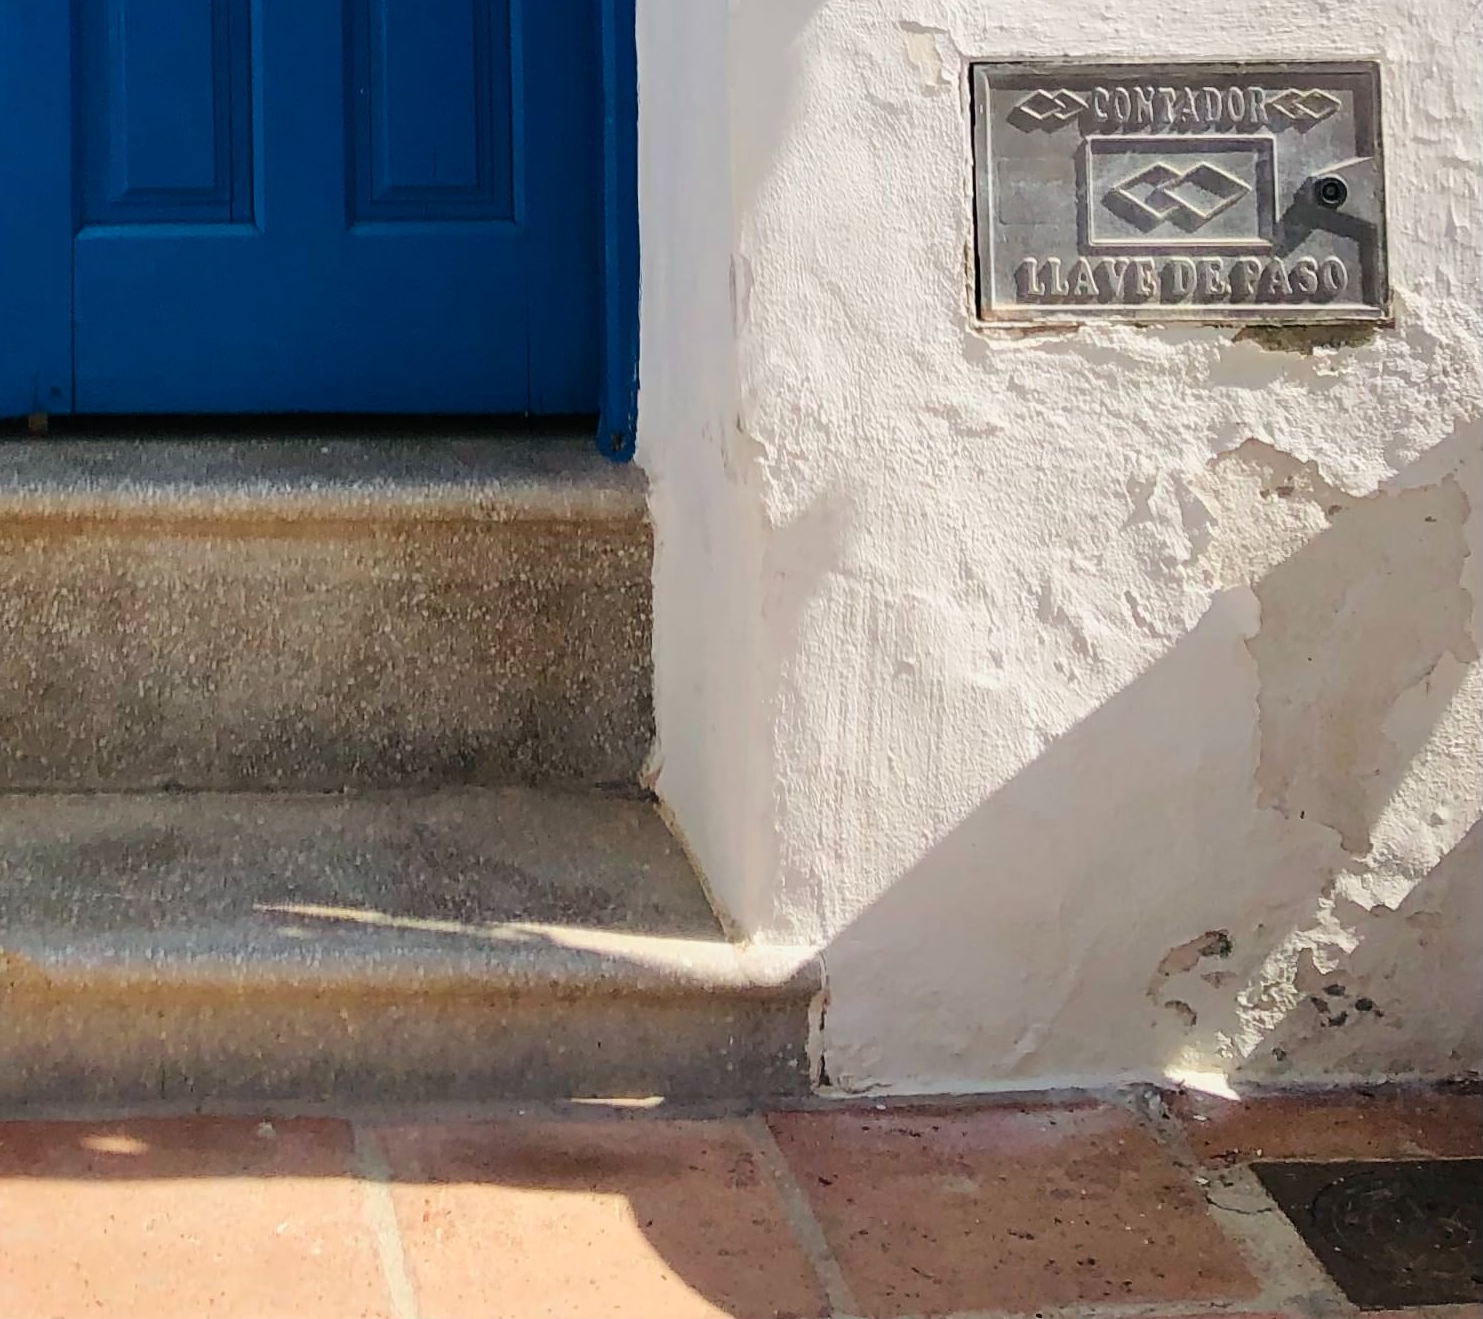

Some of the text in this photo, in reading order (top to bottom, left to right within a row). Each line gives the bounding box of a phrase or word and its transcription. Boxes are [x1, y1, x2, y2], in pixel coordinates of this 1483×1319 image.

[1091, 86, 1269, 123] CONTADOR
[1020, 255, 1349, 297] LLAVE DE PASO
